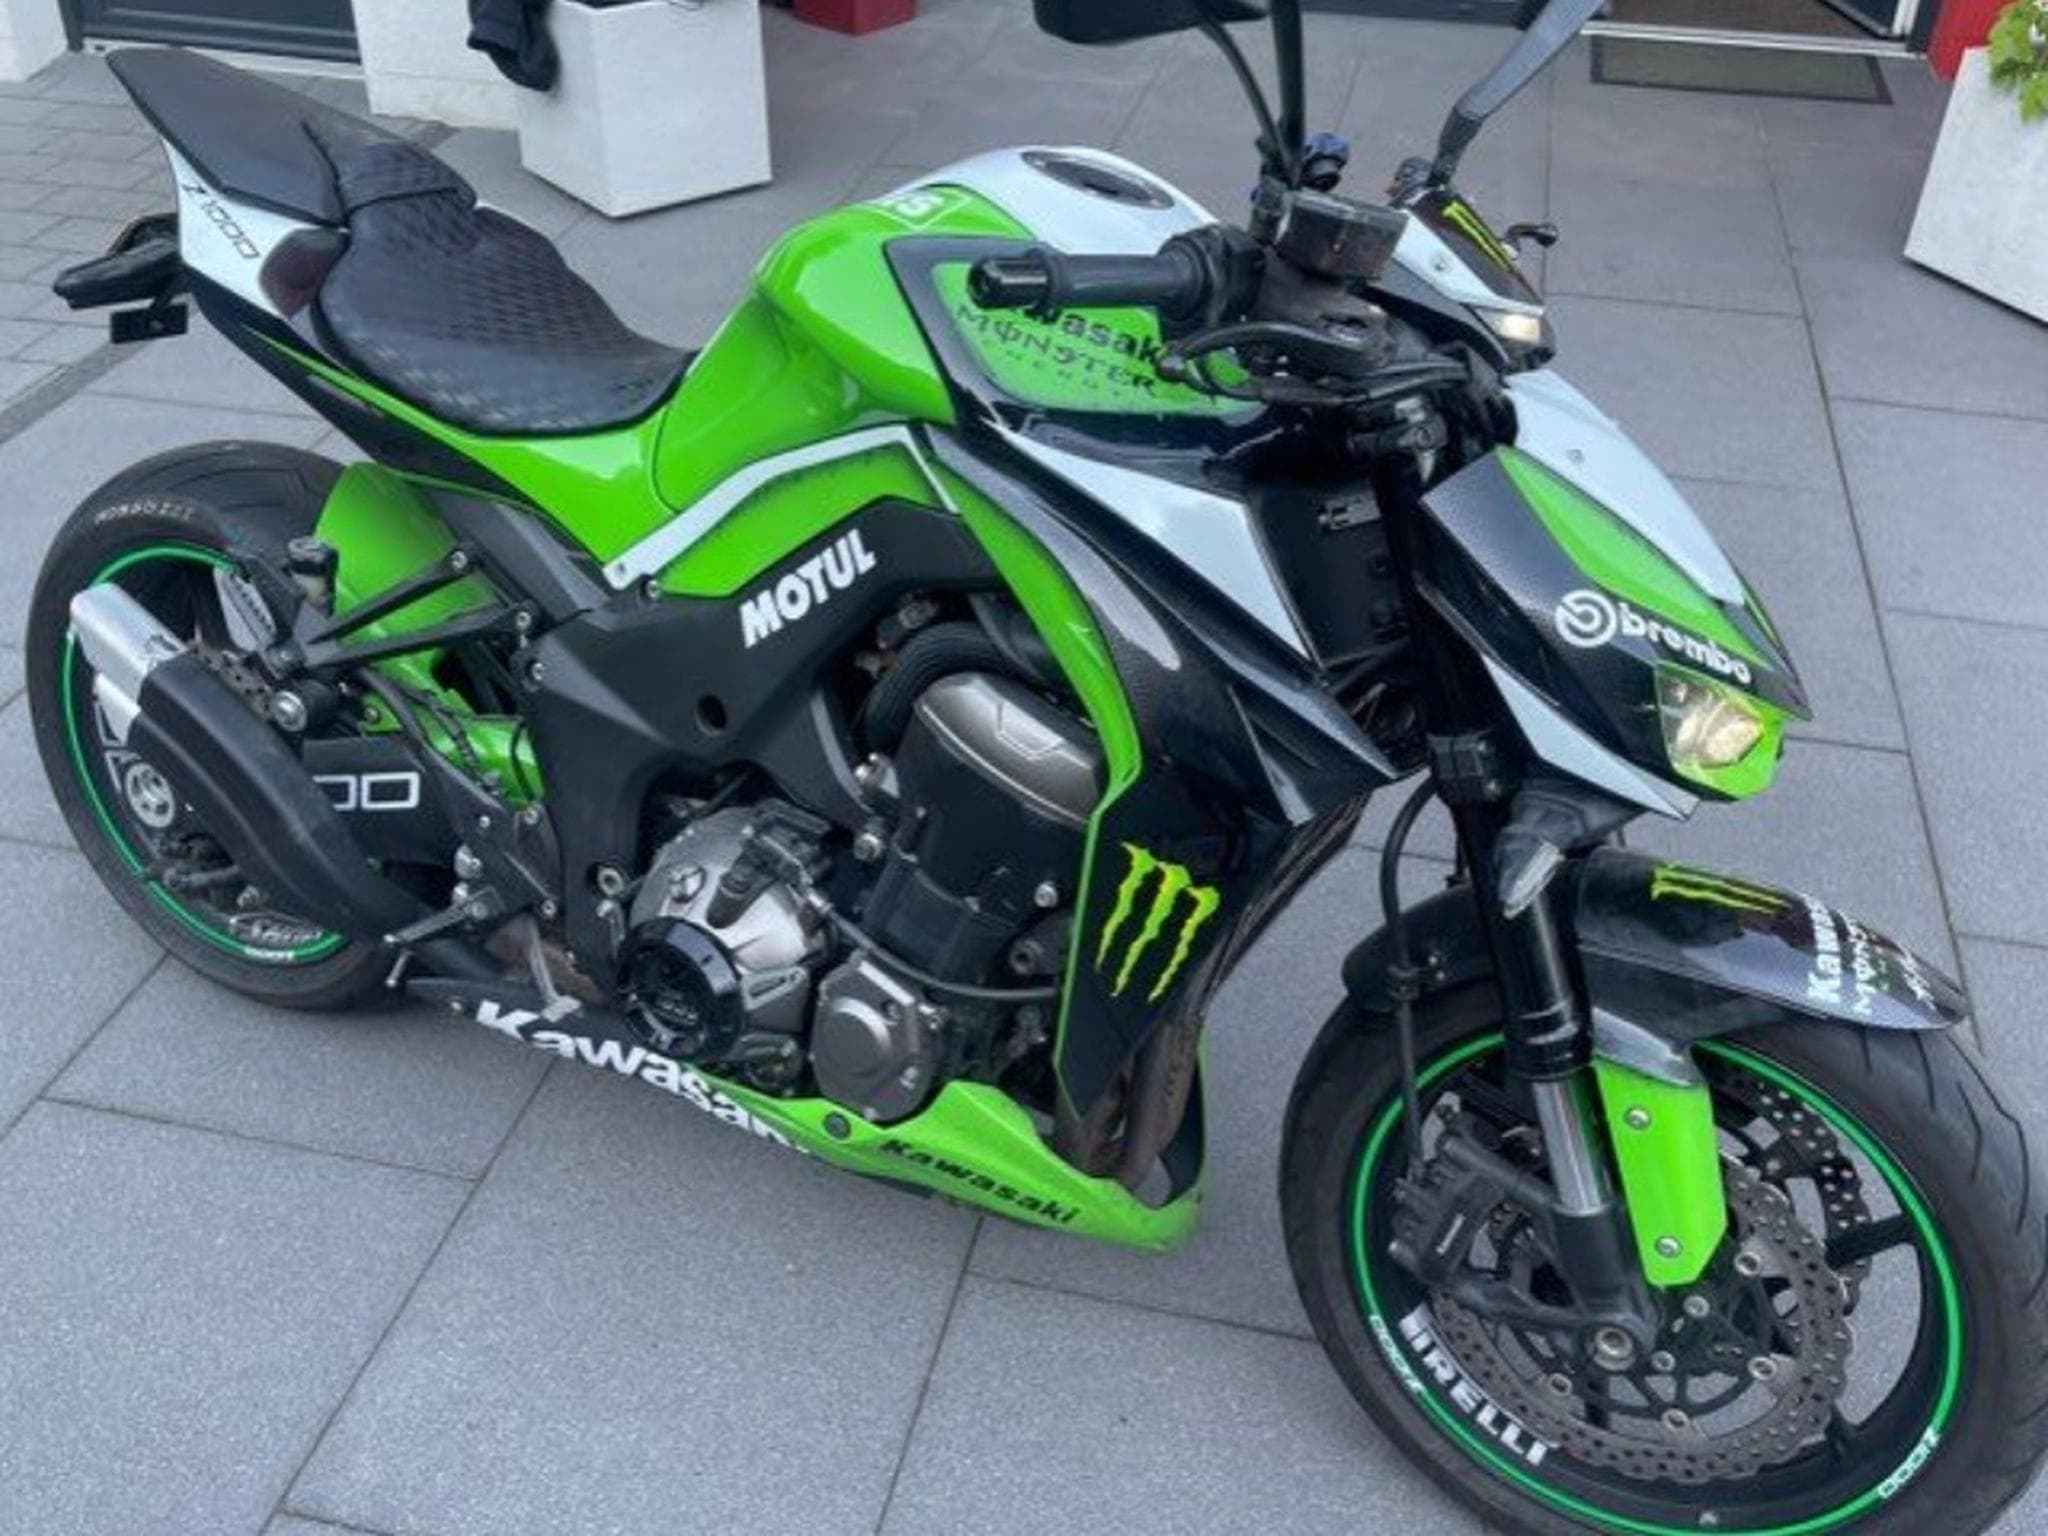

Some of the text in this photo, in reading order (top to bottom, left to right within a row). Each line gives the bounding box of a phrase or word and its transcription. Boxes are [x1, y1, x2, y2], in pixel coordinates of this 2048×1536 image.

[739, 528, 877, 649] MOTUL
[1618, 601, 1751, 685] brembo
[879, 1138, 1081, 1224] Kawasaki
